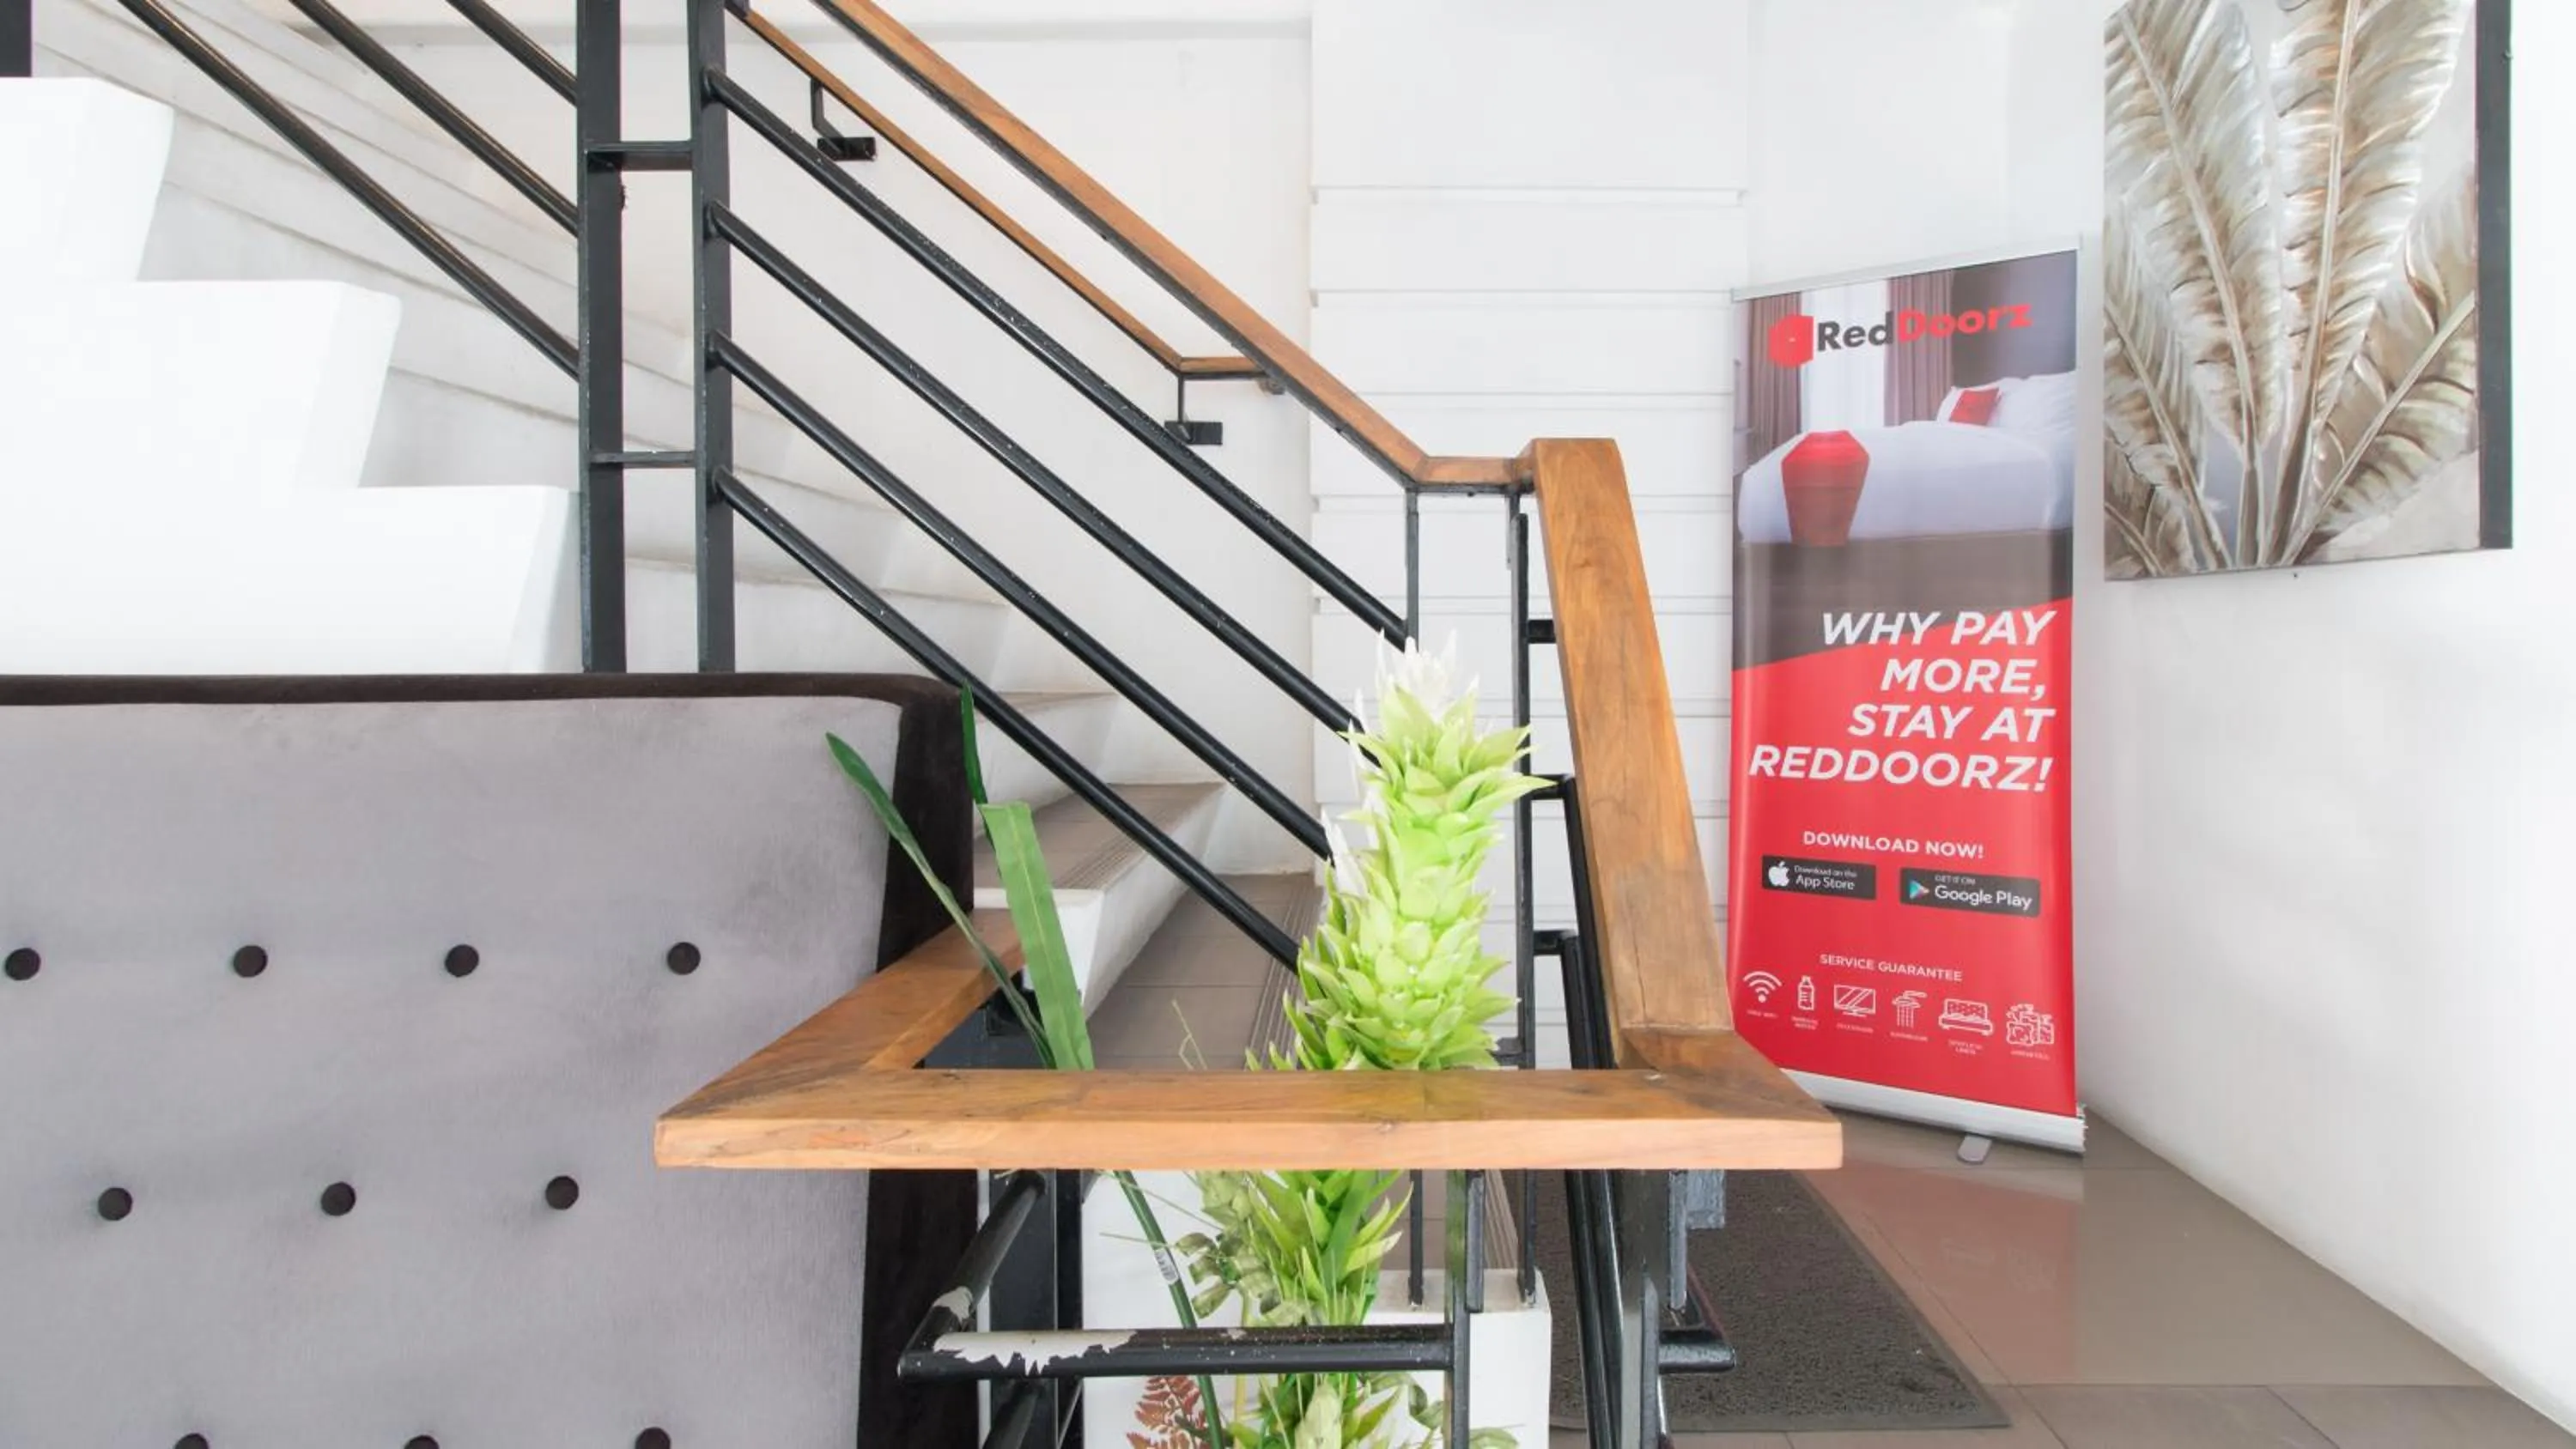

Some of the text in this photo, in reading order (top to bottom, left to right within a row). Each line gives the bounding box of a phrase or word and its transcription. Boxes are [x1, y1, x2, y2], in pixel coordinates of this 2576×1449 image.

[1823, 609, 2057, 646] WHY PAY
[1880, 658, 2046, 701] MORE,
[1847, 703, 2057, 743] STAY AT
[1748, 744, 2054, 792] REDDOORZ!
[1803, 831, 1984, 859] DOWNLOAD NOW!
[1795, 876, 1856, 891] App Store
[1934, 885, 2032, 911] Google Play
[1820, 954, 1963, 982] SERVICE GUARANTEE
